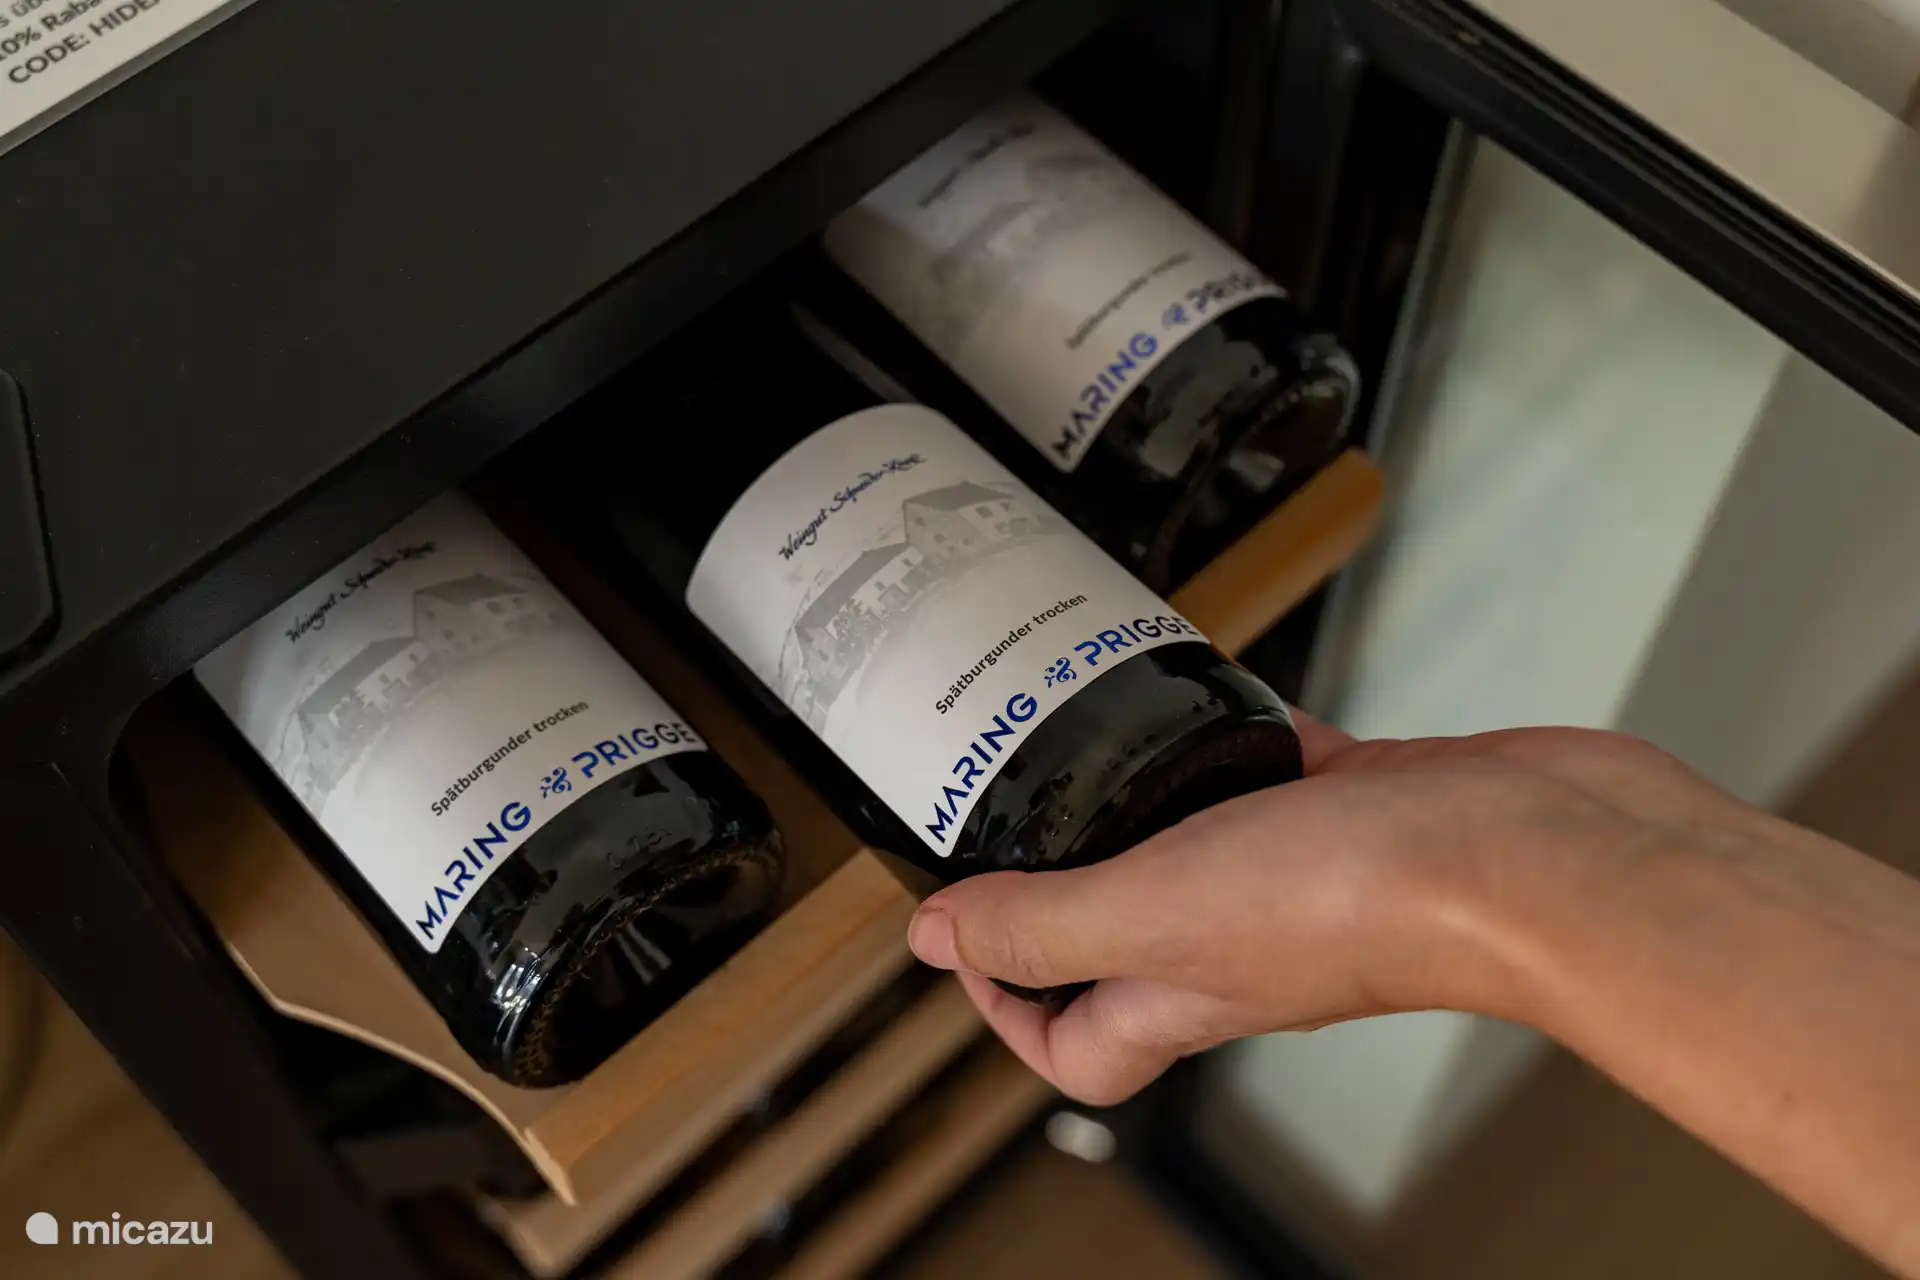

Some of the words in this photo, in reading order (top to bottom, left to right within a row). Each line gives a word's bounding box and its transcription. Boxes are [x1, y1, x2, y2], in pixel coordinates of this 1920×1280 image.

[8, 33, 91, 83] CODE:
[1052, 331, 1158, 461] MARING
[778, 508, 828, 560] Weingut
[935, 620, 1033, 715] Spätburgunder
[1032, 593, 1089, 625] trocken
[431, 727, 533, 817] Spätburgunder
[532, 701, 589, 733] trocken
[925, 692, 1038, 844] MARING
[1073, 615, 1200, 667] PRIGGE
[415, 801, 532, 941] MARING
[571, 721, 698, 779] PRIGGE
